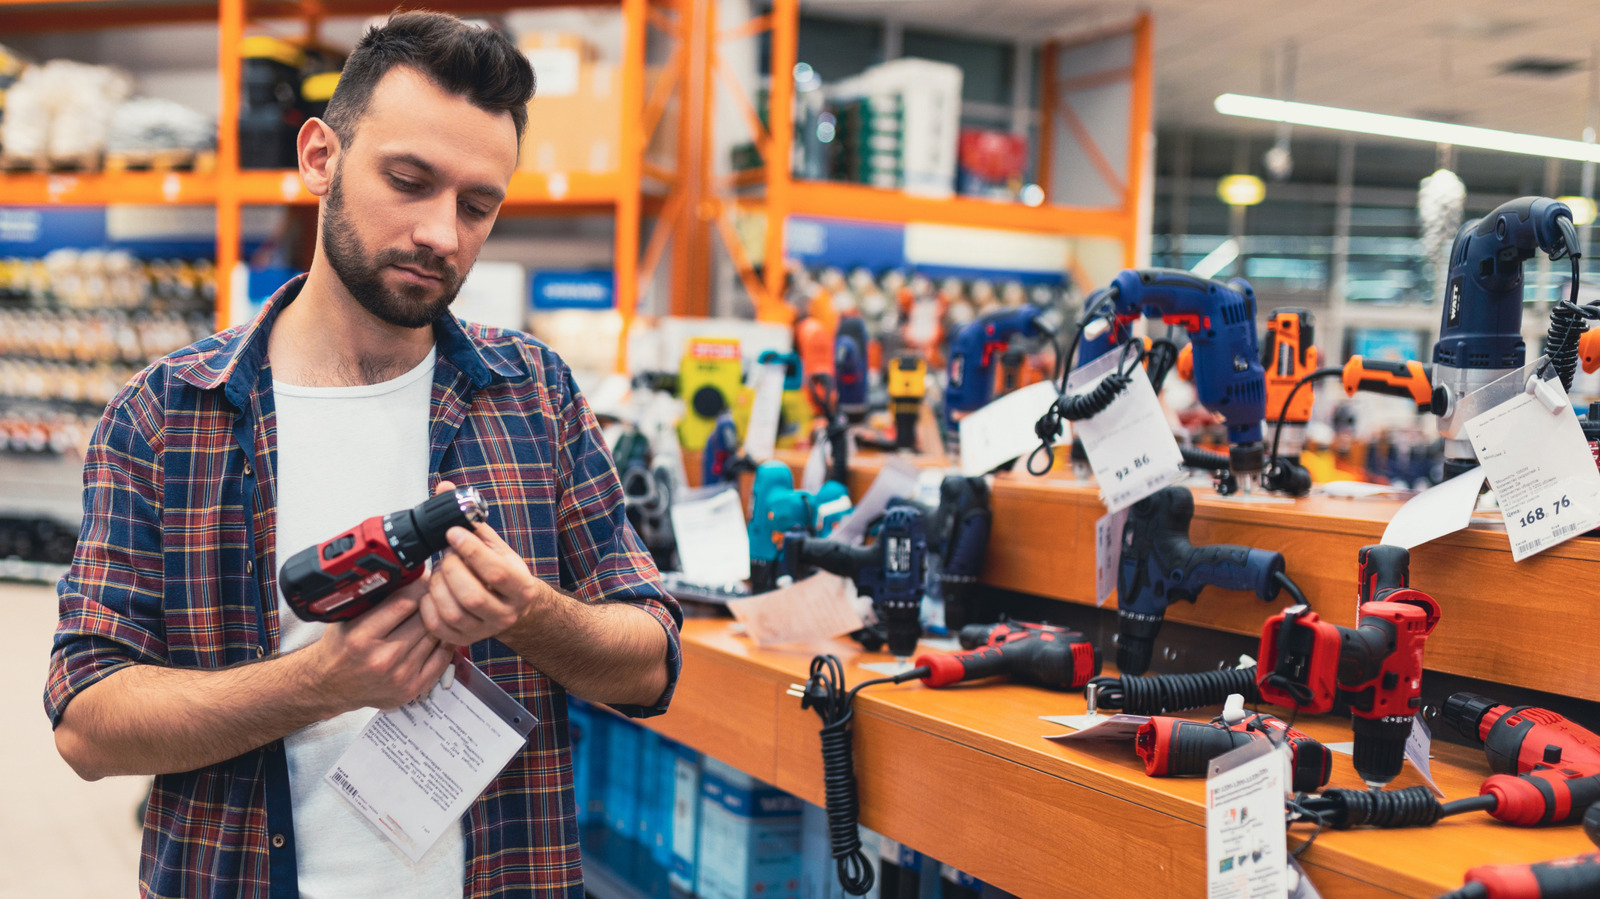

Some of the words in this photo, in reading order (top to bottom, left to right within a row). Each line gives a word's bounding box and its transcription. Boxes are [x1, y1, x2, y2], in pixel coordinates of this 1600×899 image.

[1520, 507, 1545, 527] 168
[1553, 495, 1570, 515] 76
[337, 767, 348, 778] Китай
